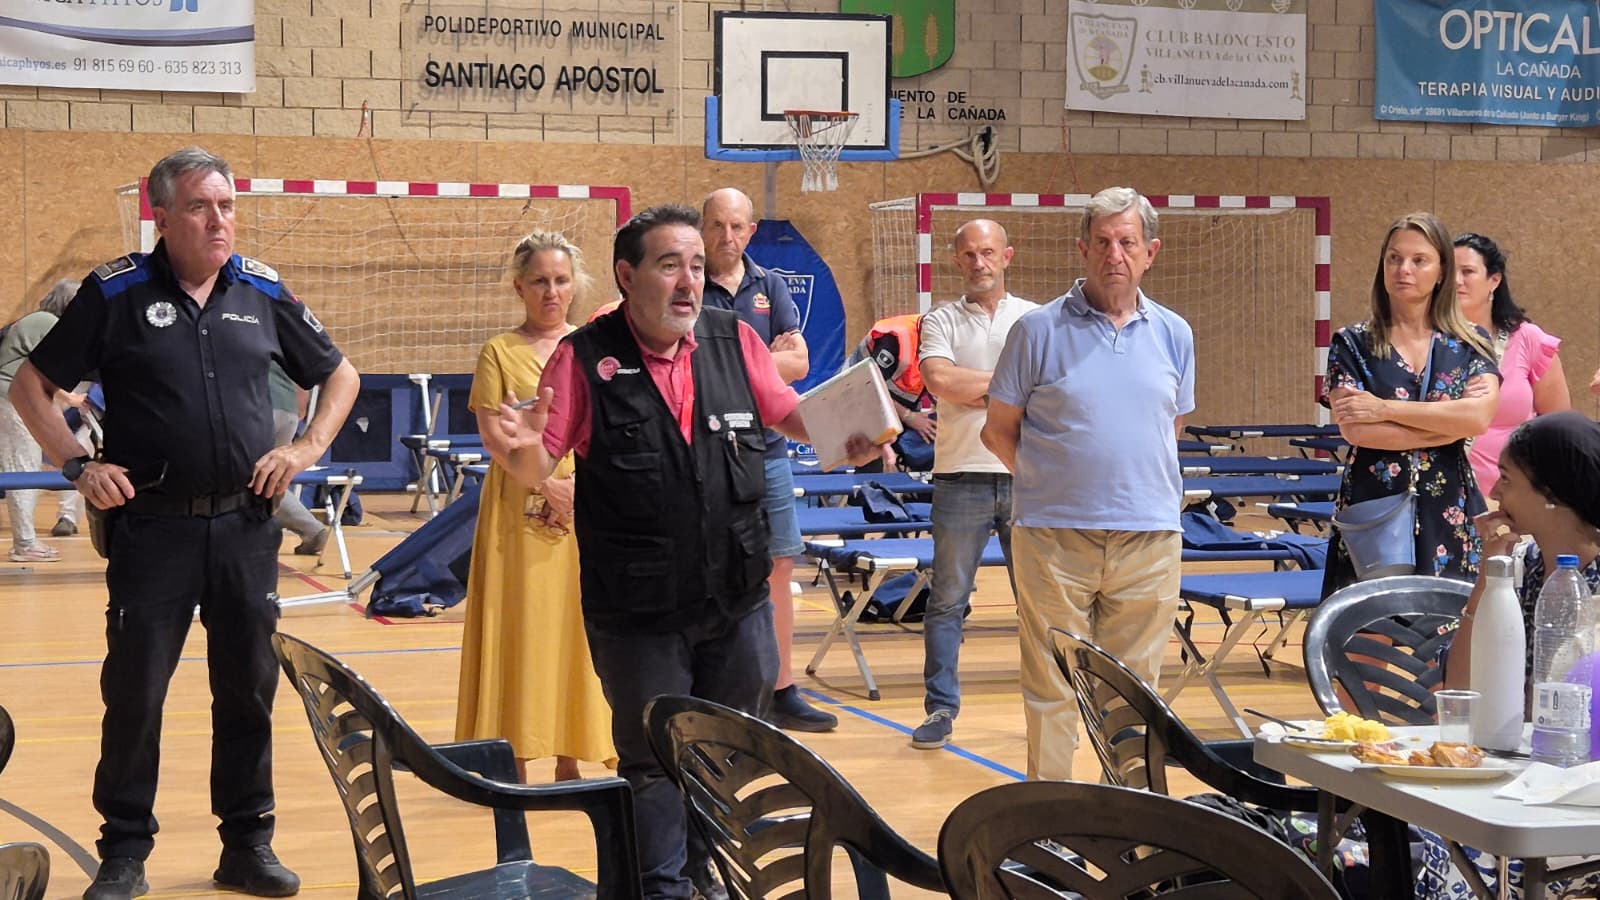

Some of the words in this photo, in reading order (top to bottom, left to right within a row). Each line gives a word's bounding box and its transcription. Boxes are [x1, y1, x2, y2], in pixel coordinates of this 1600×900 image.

[424, 15, 562, 37] POLIDEPORTIVO
[572, 21, 664, 40] MUNICIPAL
[1439, 8, 1600, 55] OPTICAL
[1145, 29, 1189, 43] CLUB
[1194, 31, 1296, 49] BALONCESTO
[1145, 47, 1221, 61] VILLANUEVA
[1247, 50, 1296, 64] CAÑADA
[73, 57, 87, 71] 91
[92, 58, 115, 72] 815
[118, 59, 135, 73] 69
[138, 59, 154, 73] 60
[164, 60, 189, 74] 635
[192, 61, 216, 74] 823
[219, 61, 242, 75] 313
[1496, 61, 1514, 76] LA
[1518, 60, 1582, 79] CAÑADA
[425, 60, 546, 91] SANTIAGO
[556, 65, 664, 94] APOSTOL
[1154, 72, 1289, 89] cb.villanuevadelacanada.com
[892, 90, 935, 103] IENTO
[947, 91, 967, 103] DE
[1418, 81, 1489, 97] TERAPIA
[1491, 84, 1543, 100] VISUAL
[1547, 86, 1556, 101] Y
[917, 107, 936, 119] LA
[947, 105, 1006, 121] CAÑADA
[1546, 111, 1569, 123] Burger
[788, 278, 806, 286] EVA
[788, 286, 807, 294] ADA
[222, 313, 259, 325] POLICÍA
